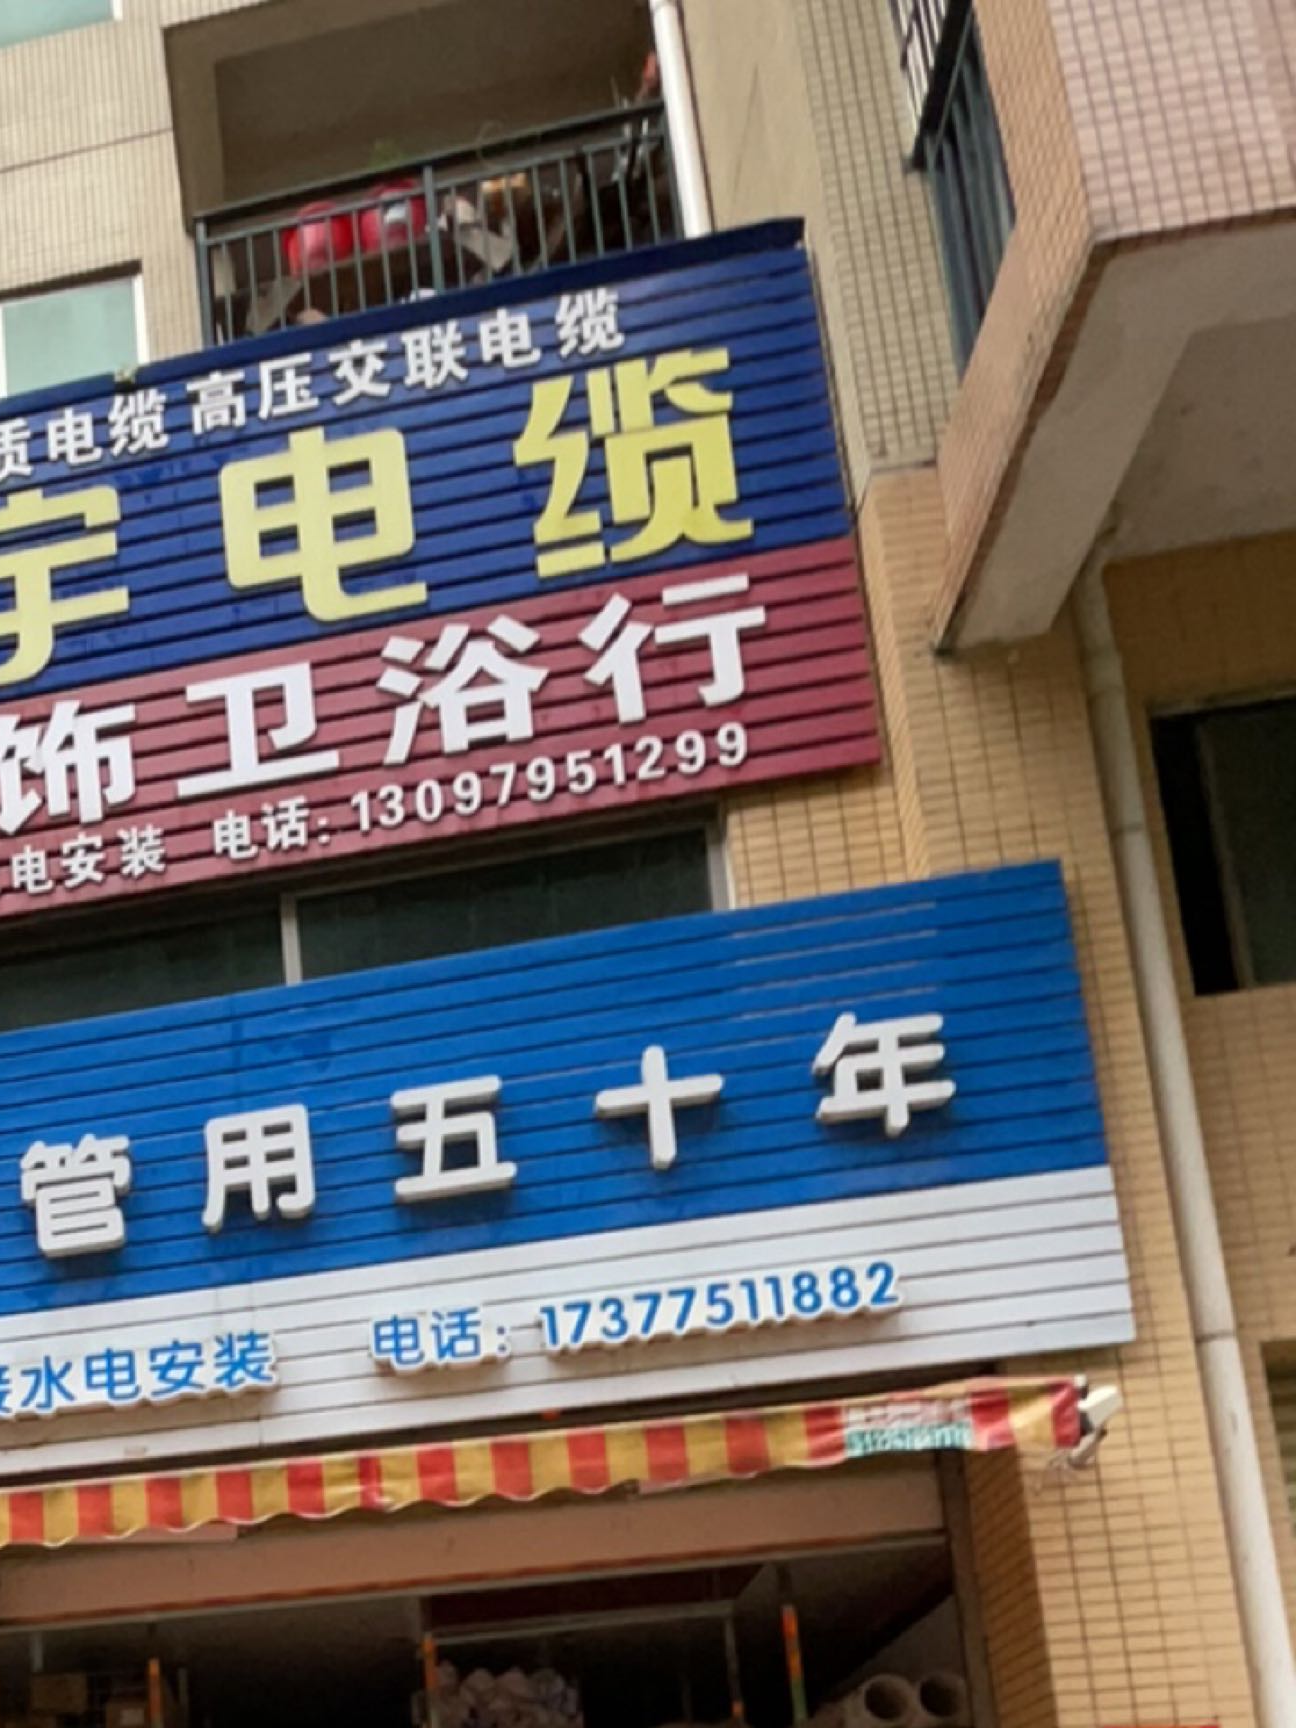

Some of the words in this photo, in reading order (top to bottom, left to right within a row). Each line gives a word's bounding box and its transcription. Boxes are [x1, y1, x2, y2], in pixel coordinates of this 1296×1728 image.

[184, 287, 629, 437] 高压交联电缆
